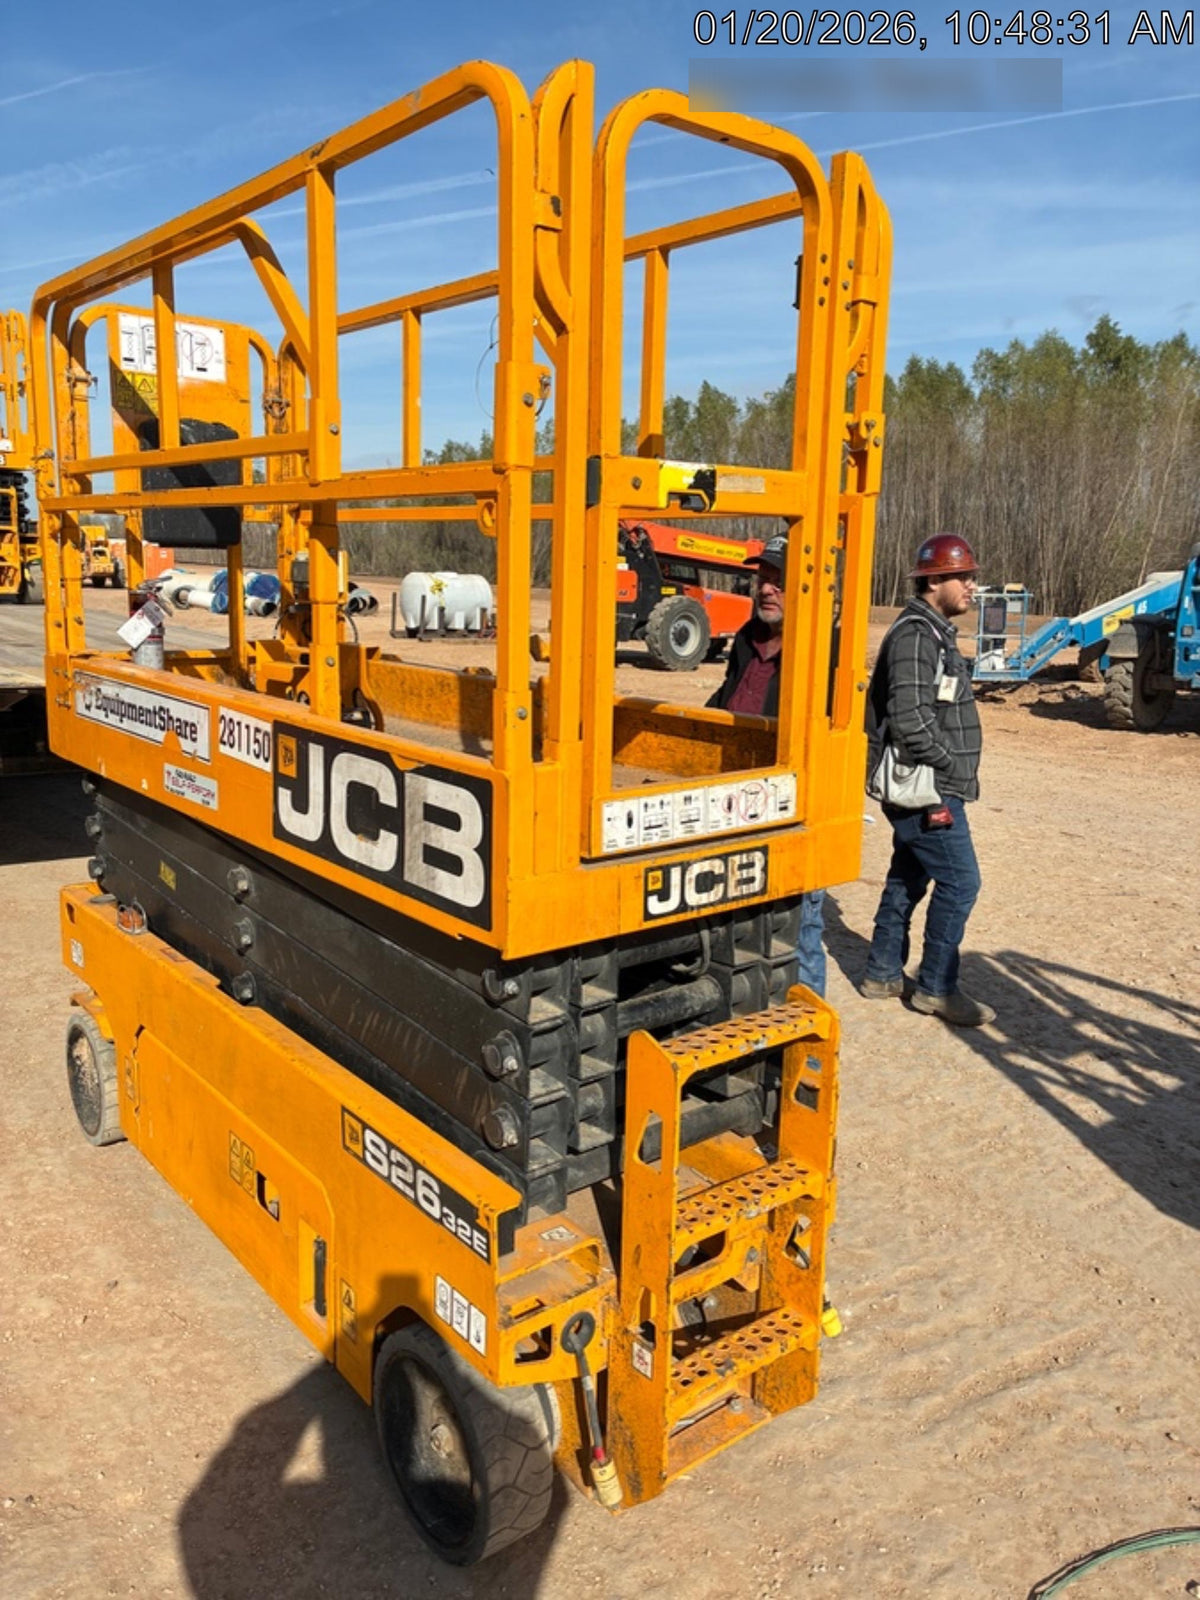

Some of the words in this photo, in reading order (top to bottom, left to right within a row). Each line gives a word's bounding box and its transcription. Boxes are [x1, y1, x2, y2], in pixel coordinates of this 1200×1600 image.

[95, 687, 198, 743] EquipmentShare
[219, 714, 271, 763] 281150
[278, 742, 485, 908] JCB
[646, 850, 766, 915] JCB
